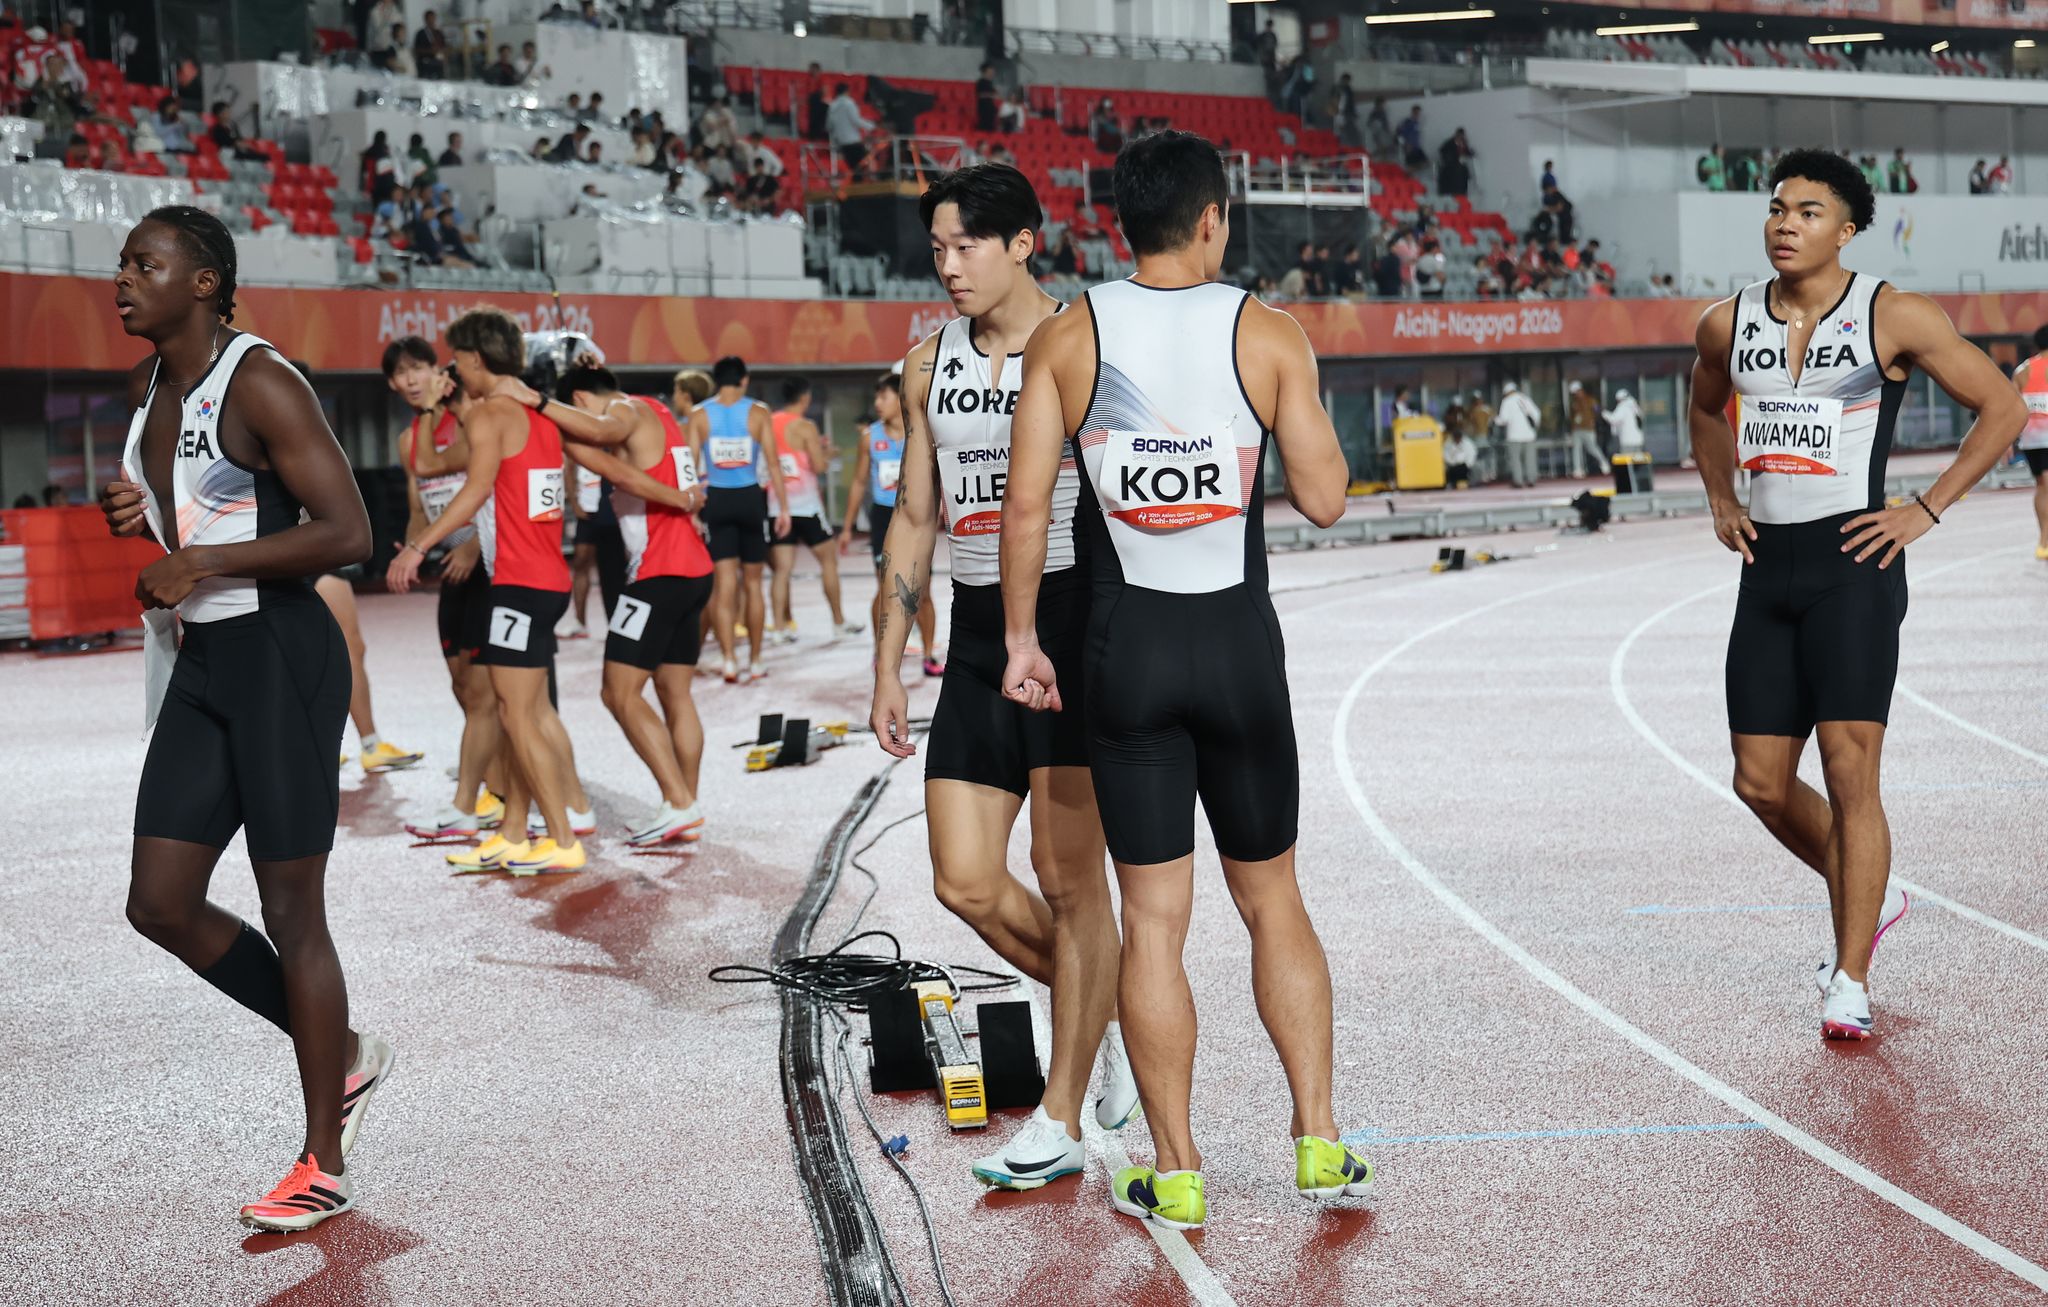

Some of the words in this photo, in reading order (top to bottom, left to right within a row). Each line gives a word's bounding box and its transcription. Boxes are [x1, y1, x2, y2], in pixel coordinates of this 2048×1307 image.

[1393, 308, 1516, 343] Aichi-Nagoya
[1519, 307, 1563, 335] 2026
[1738, 344, 1859, 373] KOREA
[937, 388, 1022, 415] KORE
[1757, 401, 1819, 414] BORNAN
[1131, 435, 1213, 454] BORNAN
[1743, 421, 1832, 449] NWAMADI
[1132, 453, 1161, 461] SPORTS
[1164, 450, 1213, 463] TECHNOLOGY
[1811, 450, 1831, 460] 482
[954, 473, 1007, 505] J.LE
[1120, 463, 1222, 503] KOR
[971, 523, 1001, 531] Aichi-Nago
[1149, 515, 1196, 525] Aichi-Nagoya
[1196, 512, 1213, 520] 2026
[504, 614, 518, 642] 7
[621, 603, 638, 629] 7
